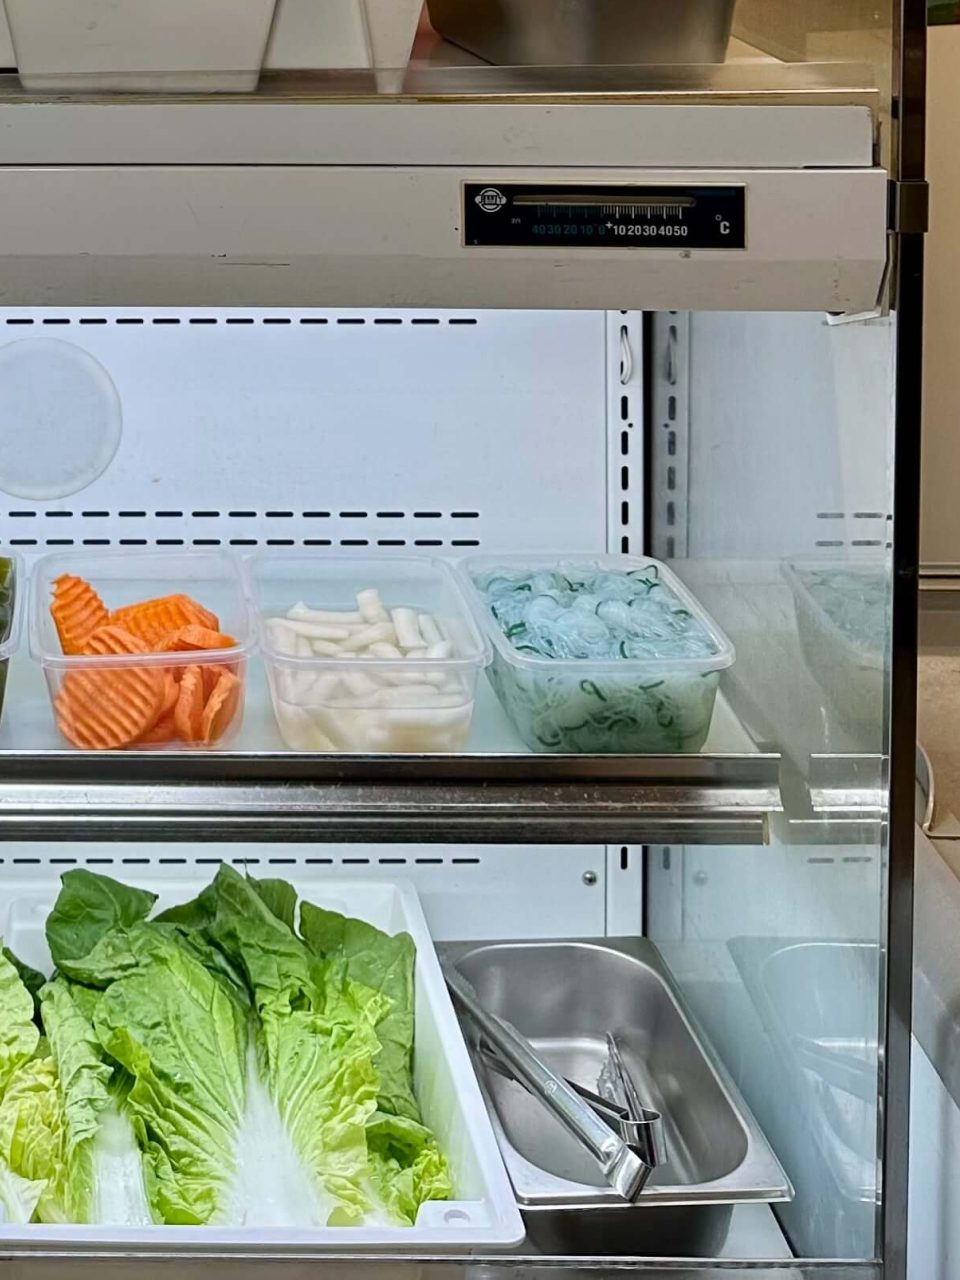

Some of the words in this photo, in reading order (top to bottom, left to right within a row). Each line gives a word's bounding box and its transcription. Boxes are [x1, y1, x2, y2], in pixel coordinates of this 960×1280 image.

[627, 225, 642, 236] 20
[642, 225, 657, 236] 30
[658, 225, 673, 236] 40
[674, 225, 688, 236] 50
